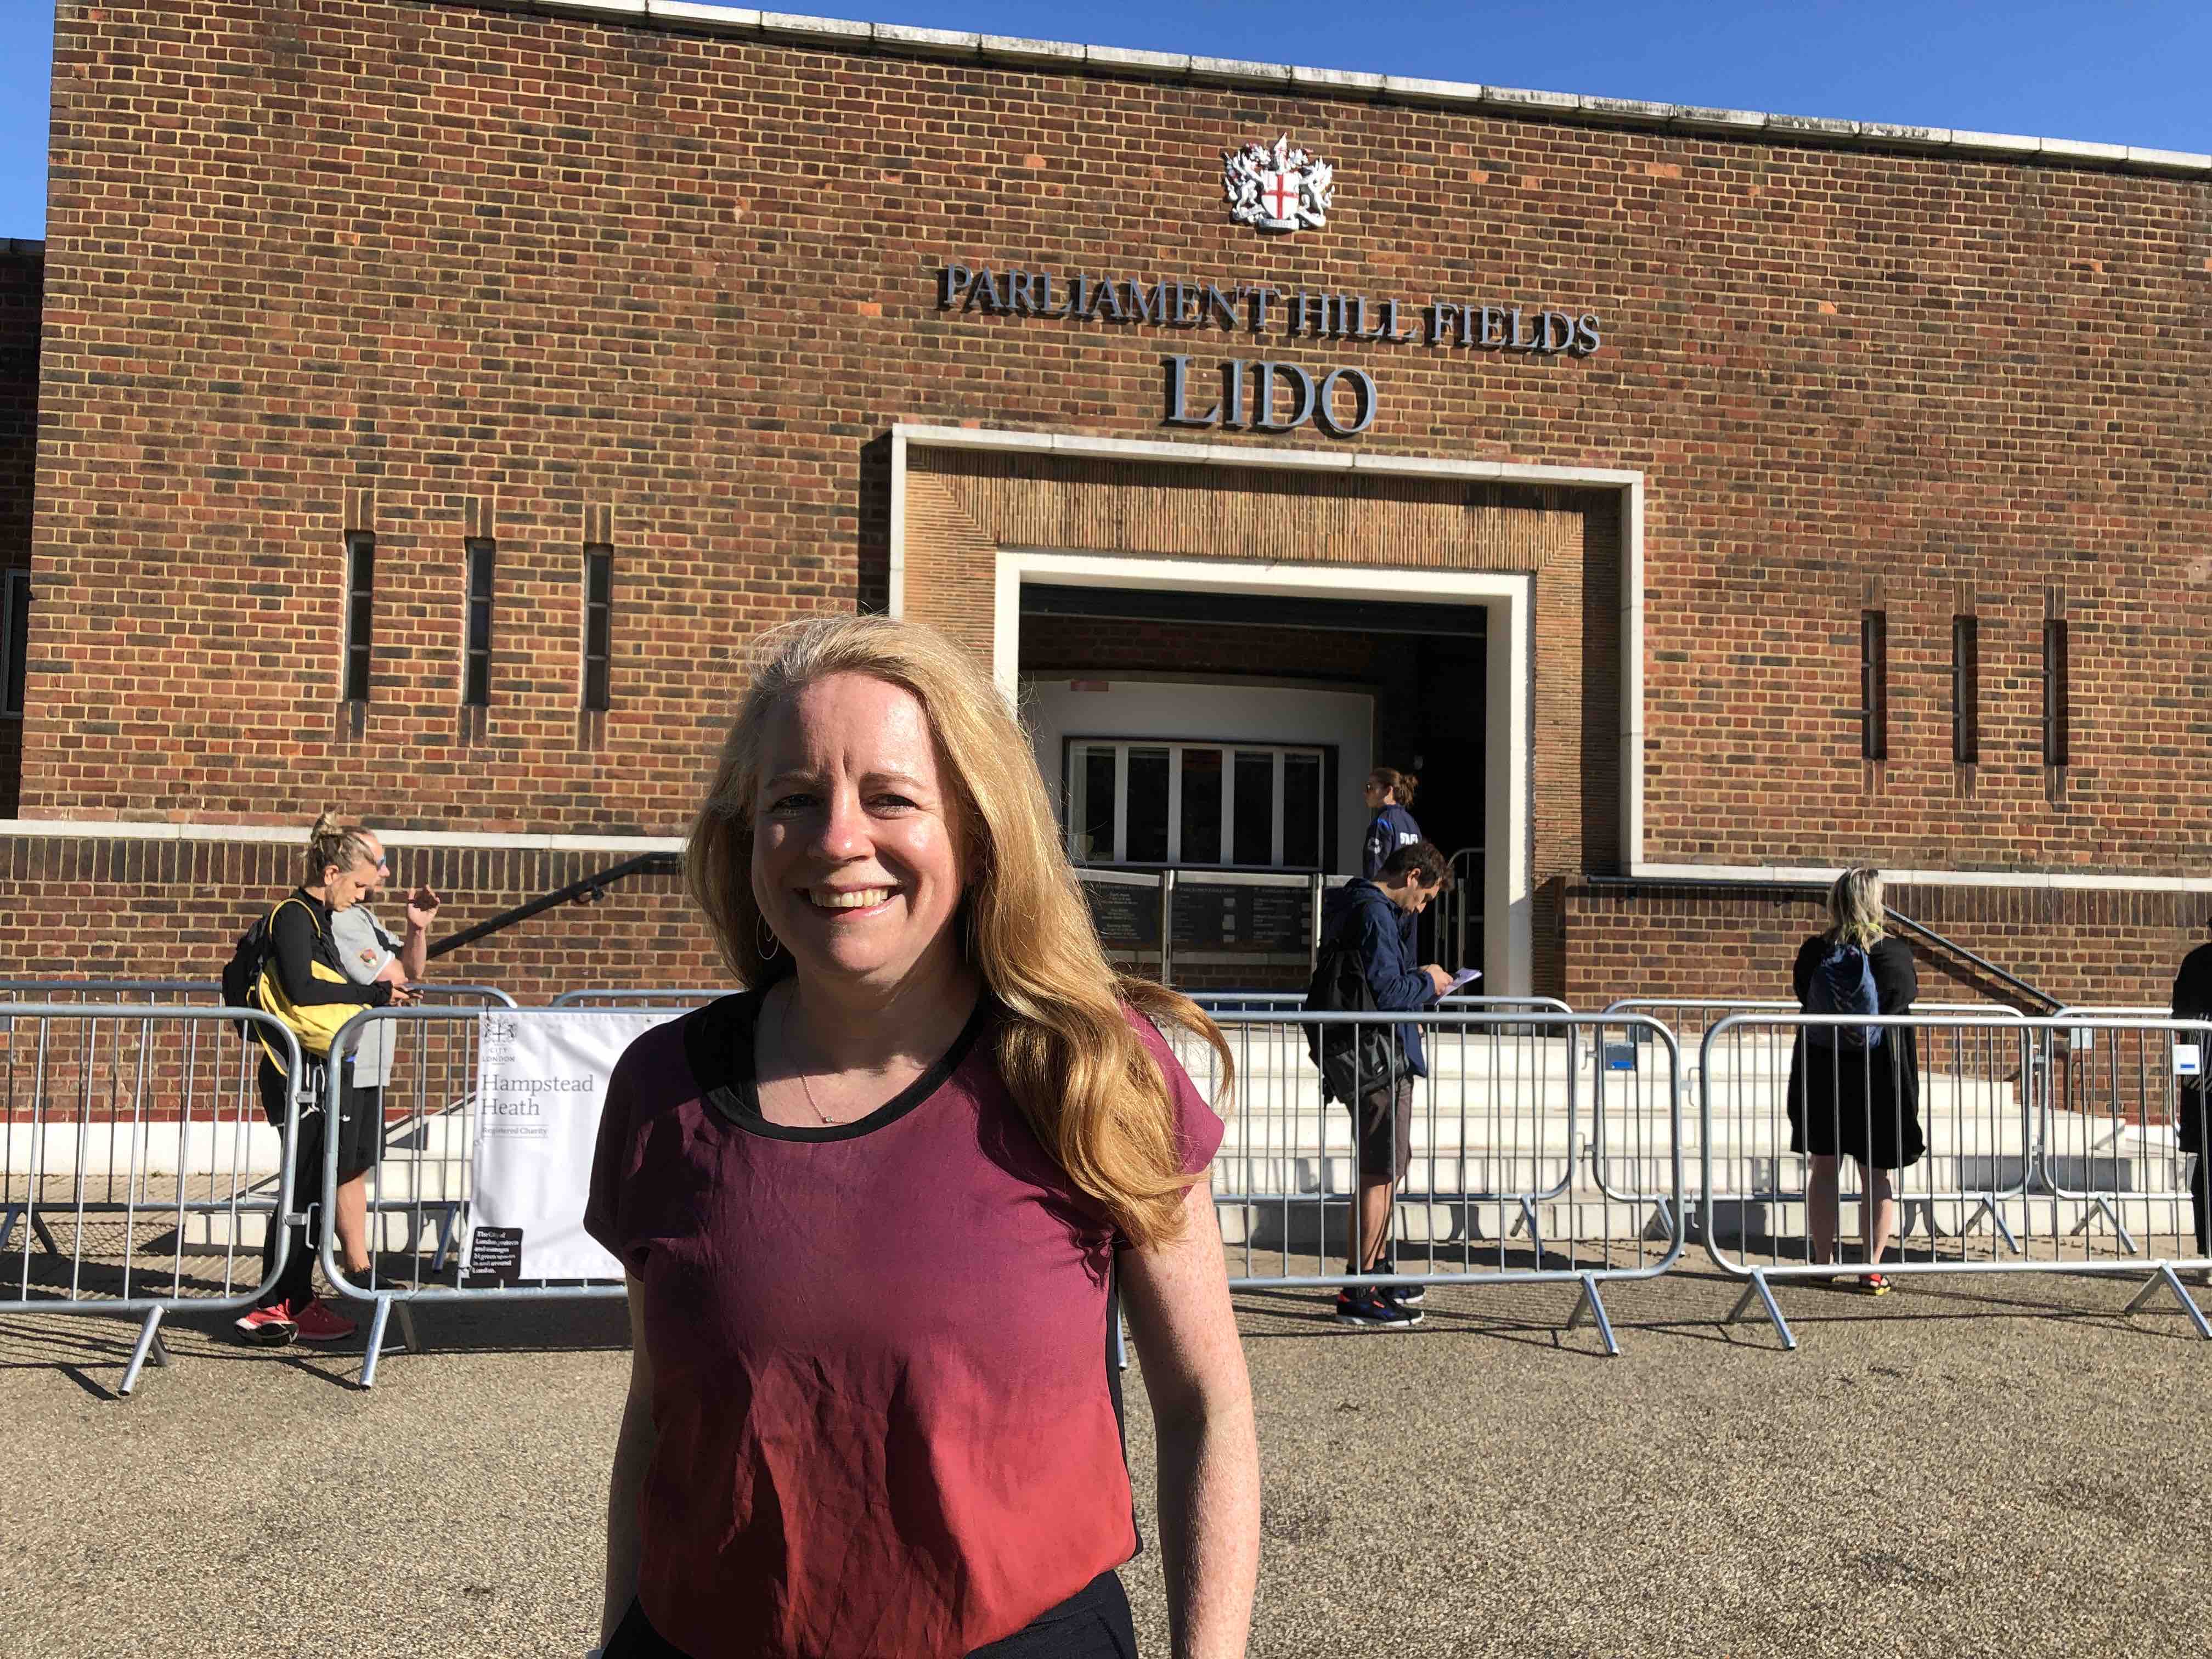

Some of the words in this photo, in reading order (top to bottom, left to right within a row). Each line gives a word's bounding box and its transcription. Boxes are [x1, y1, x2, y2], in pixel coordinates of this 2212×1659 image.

[943, 263, 1282, 326] PARLIAMENT
[1297, 291, 1417, 338] HILL
[1430, 301, 1601, 353] FIELDS
[1169, 355, 1378, 433] LIDO
[482, 1074, 594, 1097] Hampstead
[482, 1098, 540, 1116] Heath
[482, 1127, 518, 1136] Registered
[520, 1127, 547, 1136] Charity
